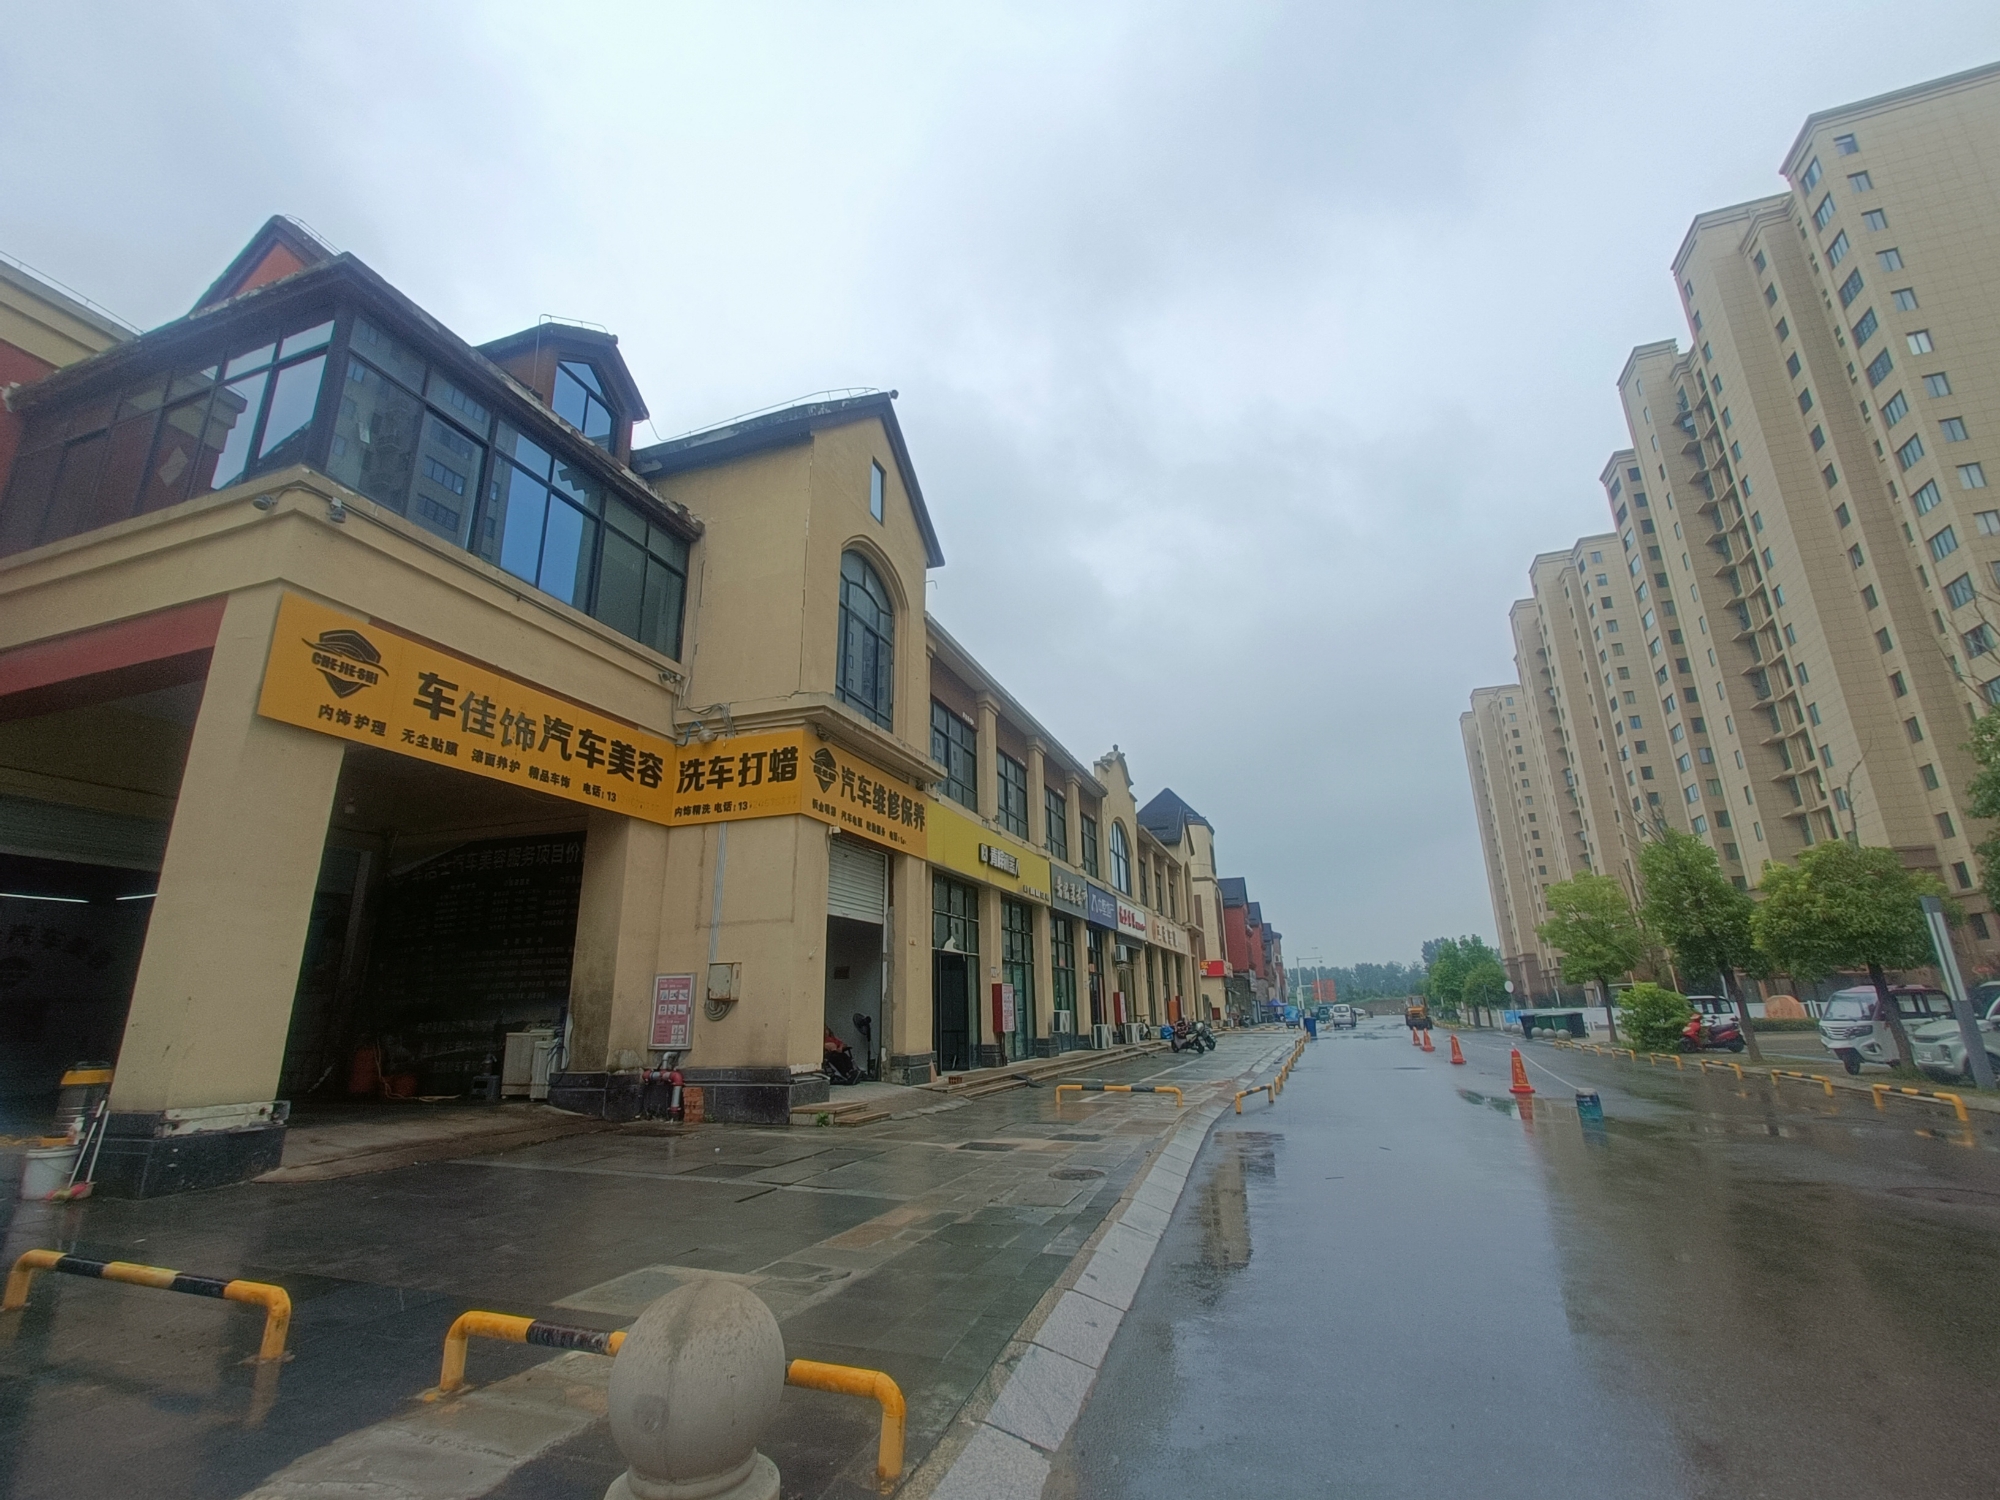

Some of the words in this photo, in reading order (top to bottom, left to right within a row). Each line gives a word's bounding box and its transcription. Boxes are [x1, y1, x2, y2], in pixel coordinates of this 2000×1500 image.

[318, 704, 386, 737] 内饰护理
[401, 728, 459, 756] 无尘贴膜
[528, 765, 571, 788] 精品车饰
[413, 671, 663, 789] 车佳饰汽车美容
[677, 746, 799, 793] 洗车打蜡
[841, 765, 926, 833] 汽车维修保养
[674, 804, 711, 818] 内饰精洗
